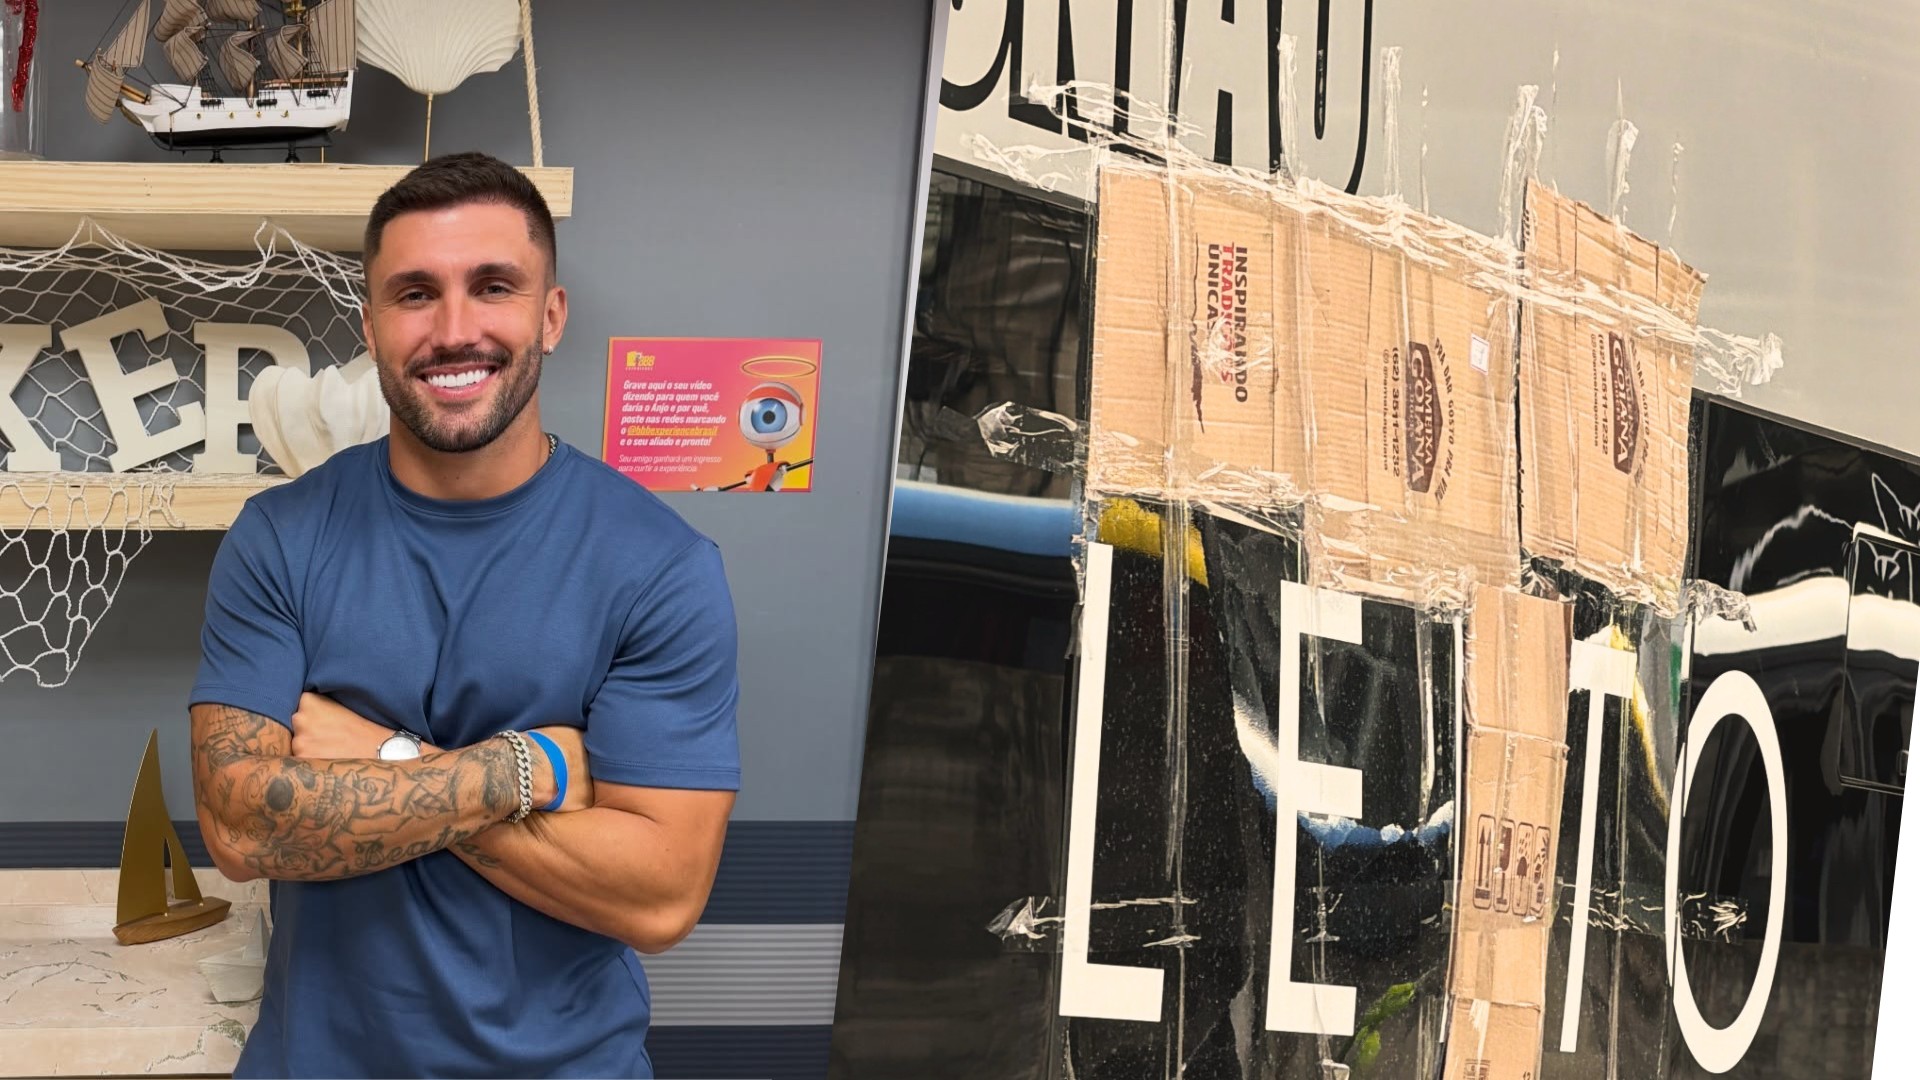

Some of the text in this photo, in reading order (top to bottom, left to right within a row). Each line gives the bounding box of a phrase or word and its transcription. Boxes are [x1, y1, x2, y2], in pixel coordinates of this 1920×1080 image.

[1234, 246, 1248, 403] INSPIRANDO
[1444, 366, 1452, 394] DAR
[623, 381, 647, 389] Grave
[648, 381, 666, 391] aqui
[690, 381, 712, 389] vídeo
[623, 392, 719, 402] dizendo para quem você
[1613, 340, 1628, 463] GOIANA
[622, 404, 643, 412] daria
[651, 403, 669, 414] Anjo
[1391, 347, 1400, 477] (62) 3511-1232
[621, 416, 644, 425] poste
[662, 415, 685, 423] redes
[686, 415, 726, 423] marcando
[1411, 349, 1424, 482] GOIANA
[681, 438, 712, 447] pronto!
[619, 455, 632, 463] Seu
[632, 456, 652, 465] amigo
[693, 456, 721, 465] ingresso
